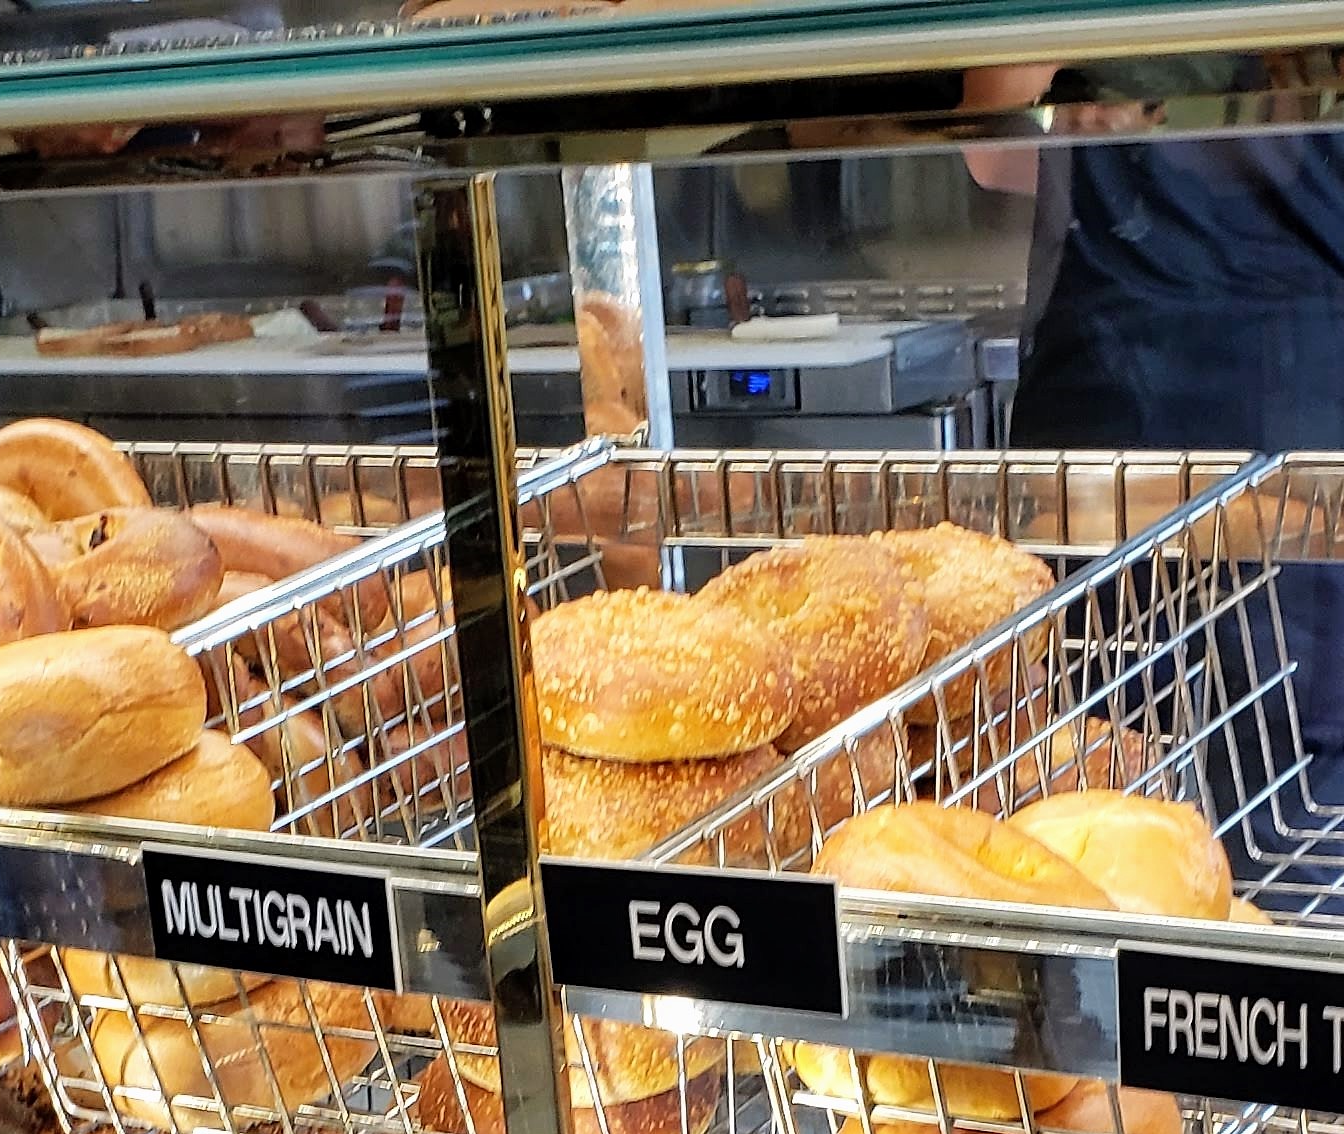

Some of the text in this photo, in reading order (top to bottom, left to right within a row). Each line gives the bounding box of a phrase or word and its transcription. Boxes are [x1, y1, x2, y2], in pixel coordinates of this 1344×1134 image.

[160, 880, 373, 957] MULTIGRAIN
[629, 900, 745, 968] EGG
[1144, 987, 1307, 1069] FRENCH
